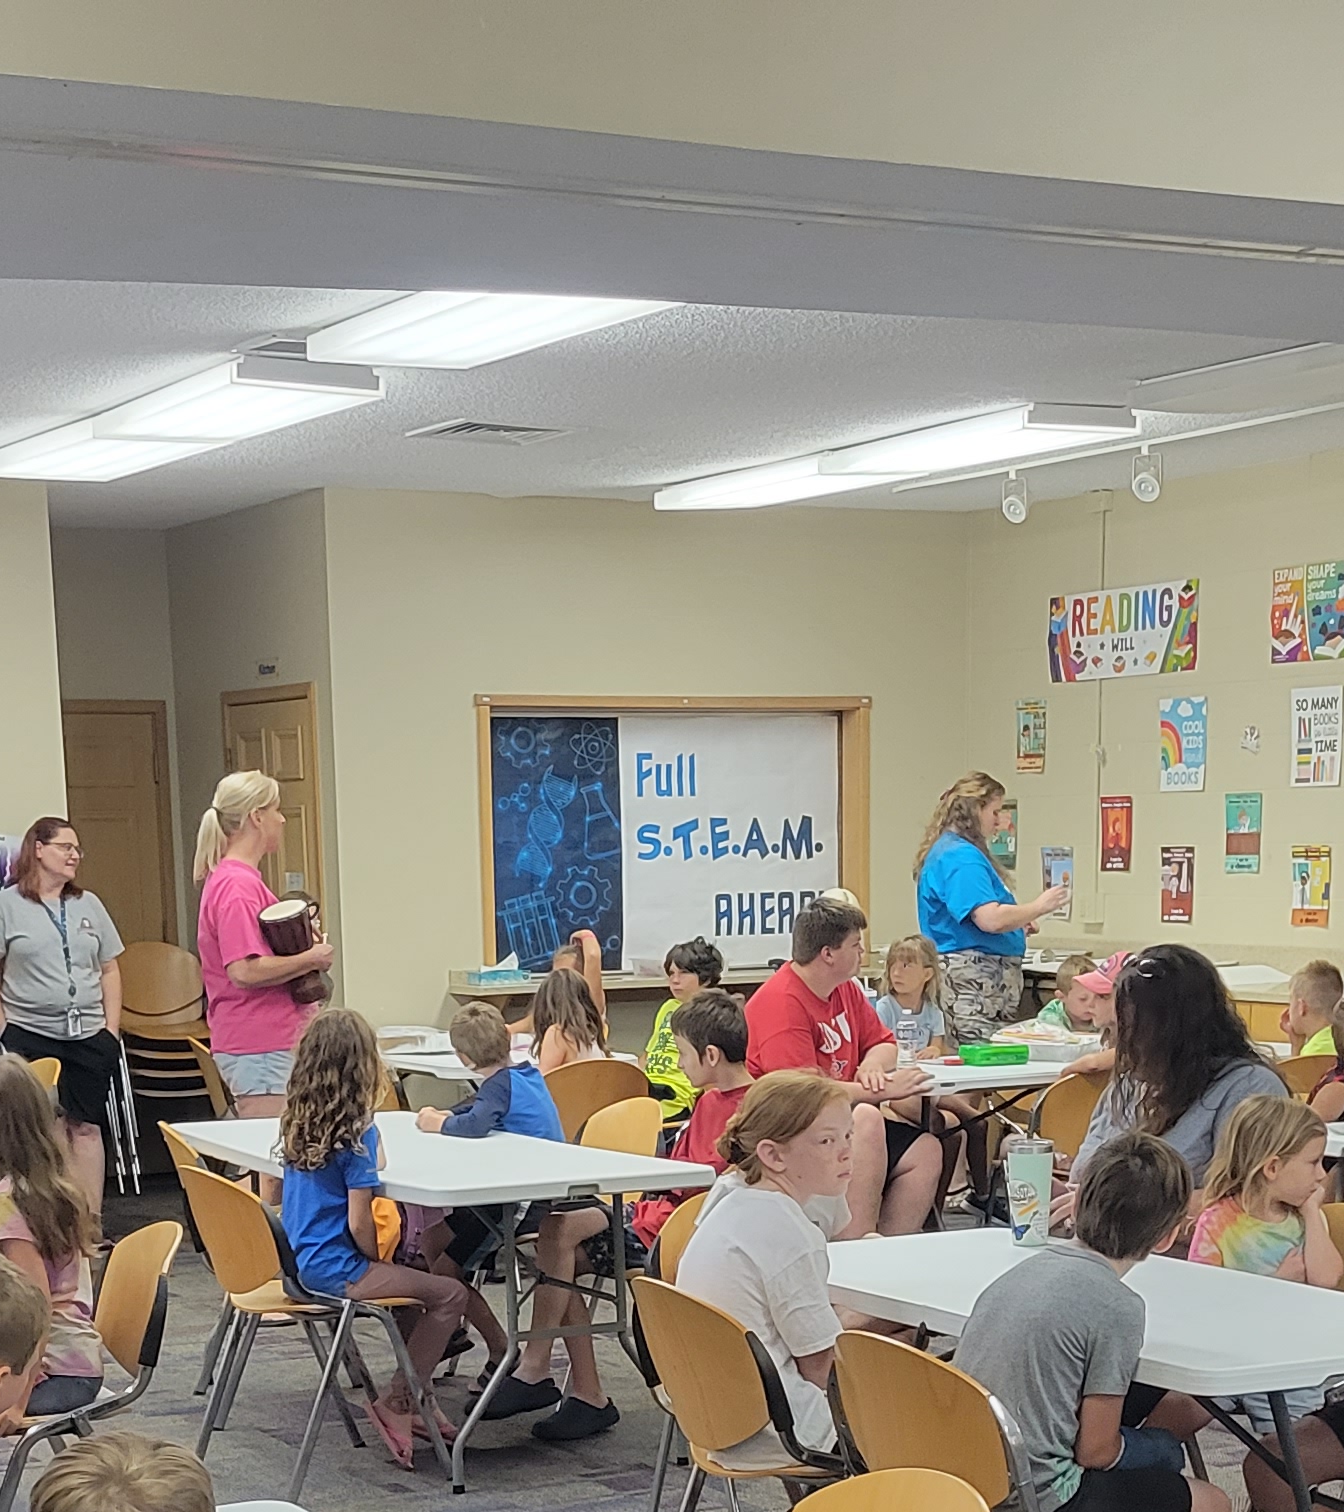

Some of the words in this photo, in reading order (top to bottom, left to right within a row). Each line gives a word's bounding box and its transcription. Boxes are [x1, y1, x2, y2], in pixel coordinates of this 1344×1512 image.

[1275, 567, 1303, 582] EXPAND
[1308, 563, 1336, 579] SHAPE
[1274, 582, 1291, 596] your
[1307, 579, 1325, 592] your
[1307, 589, 1336, 600] dreams
[1072, 588, 1173, 638] READING
[1112, 637, 1134, 652] WILL
[1296, 699, 1308, 711] SO
[1311, 697, 1338, 710] MANY
[1313, 713, 1338, 725] BOOKS
[1182, 721, 1204, 733] COOL
[1183, 735, 1203, 749] KIDS
[1315, 740, 1337, 752] TIME
[636, 753, 696, 797] Full
[1167, 771, 1199, 785] BOOKS
[637, 815, 823, 861] S.T.E.A.M.
